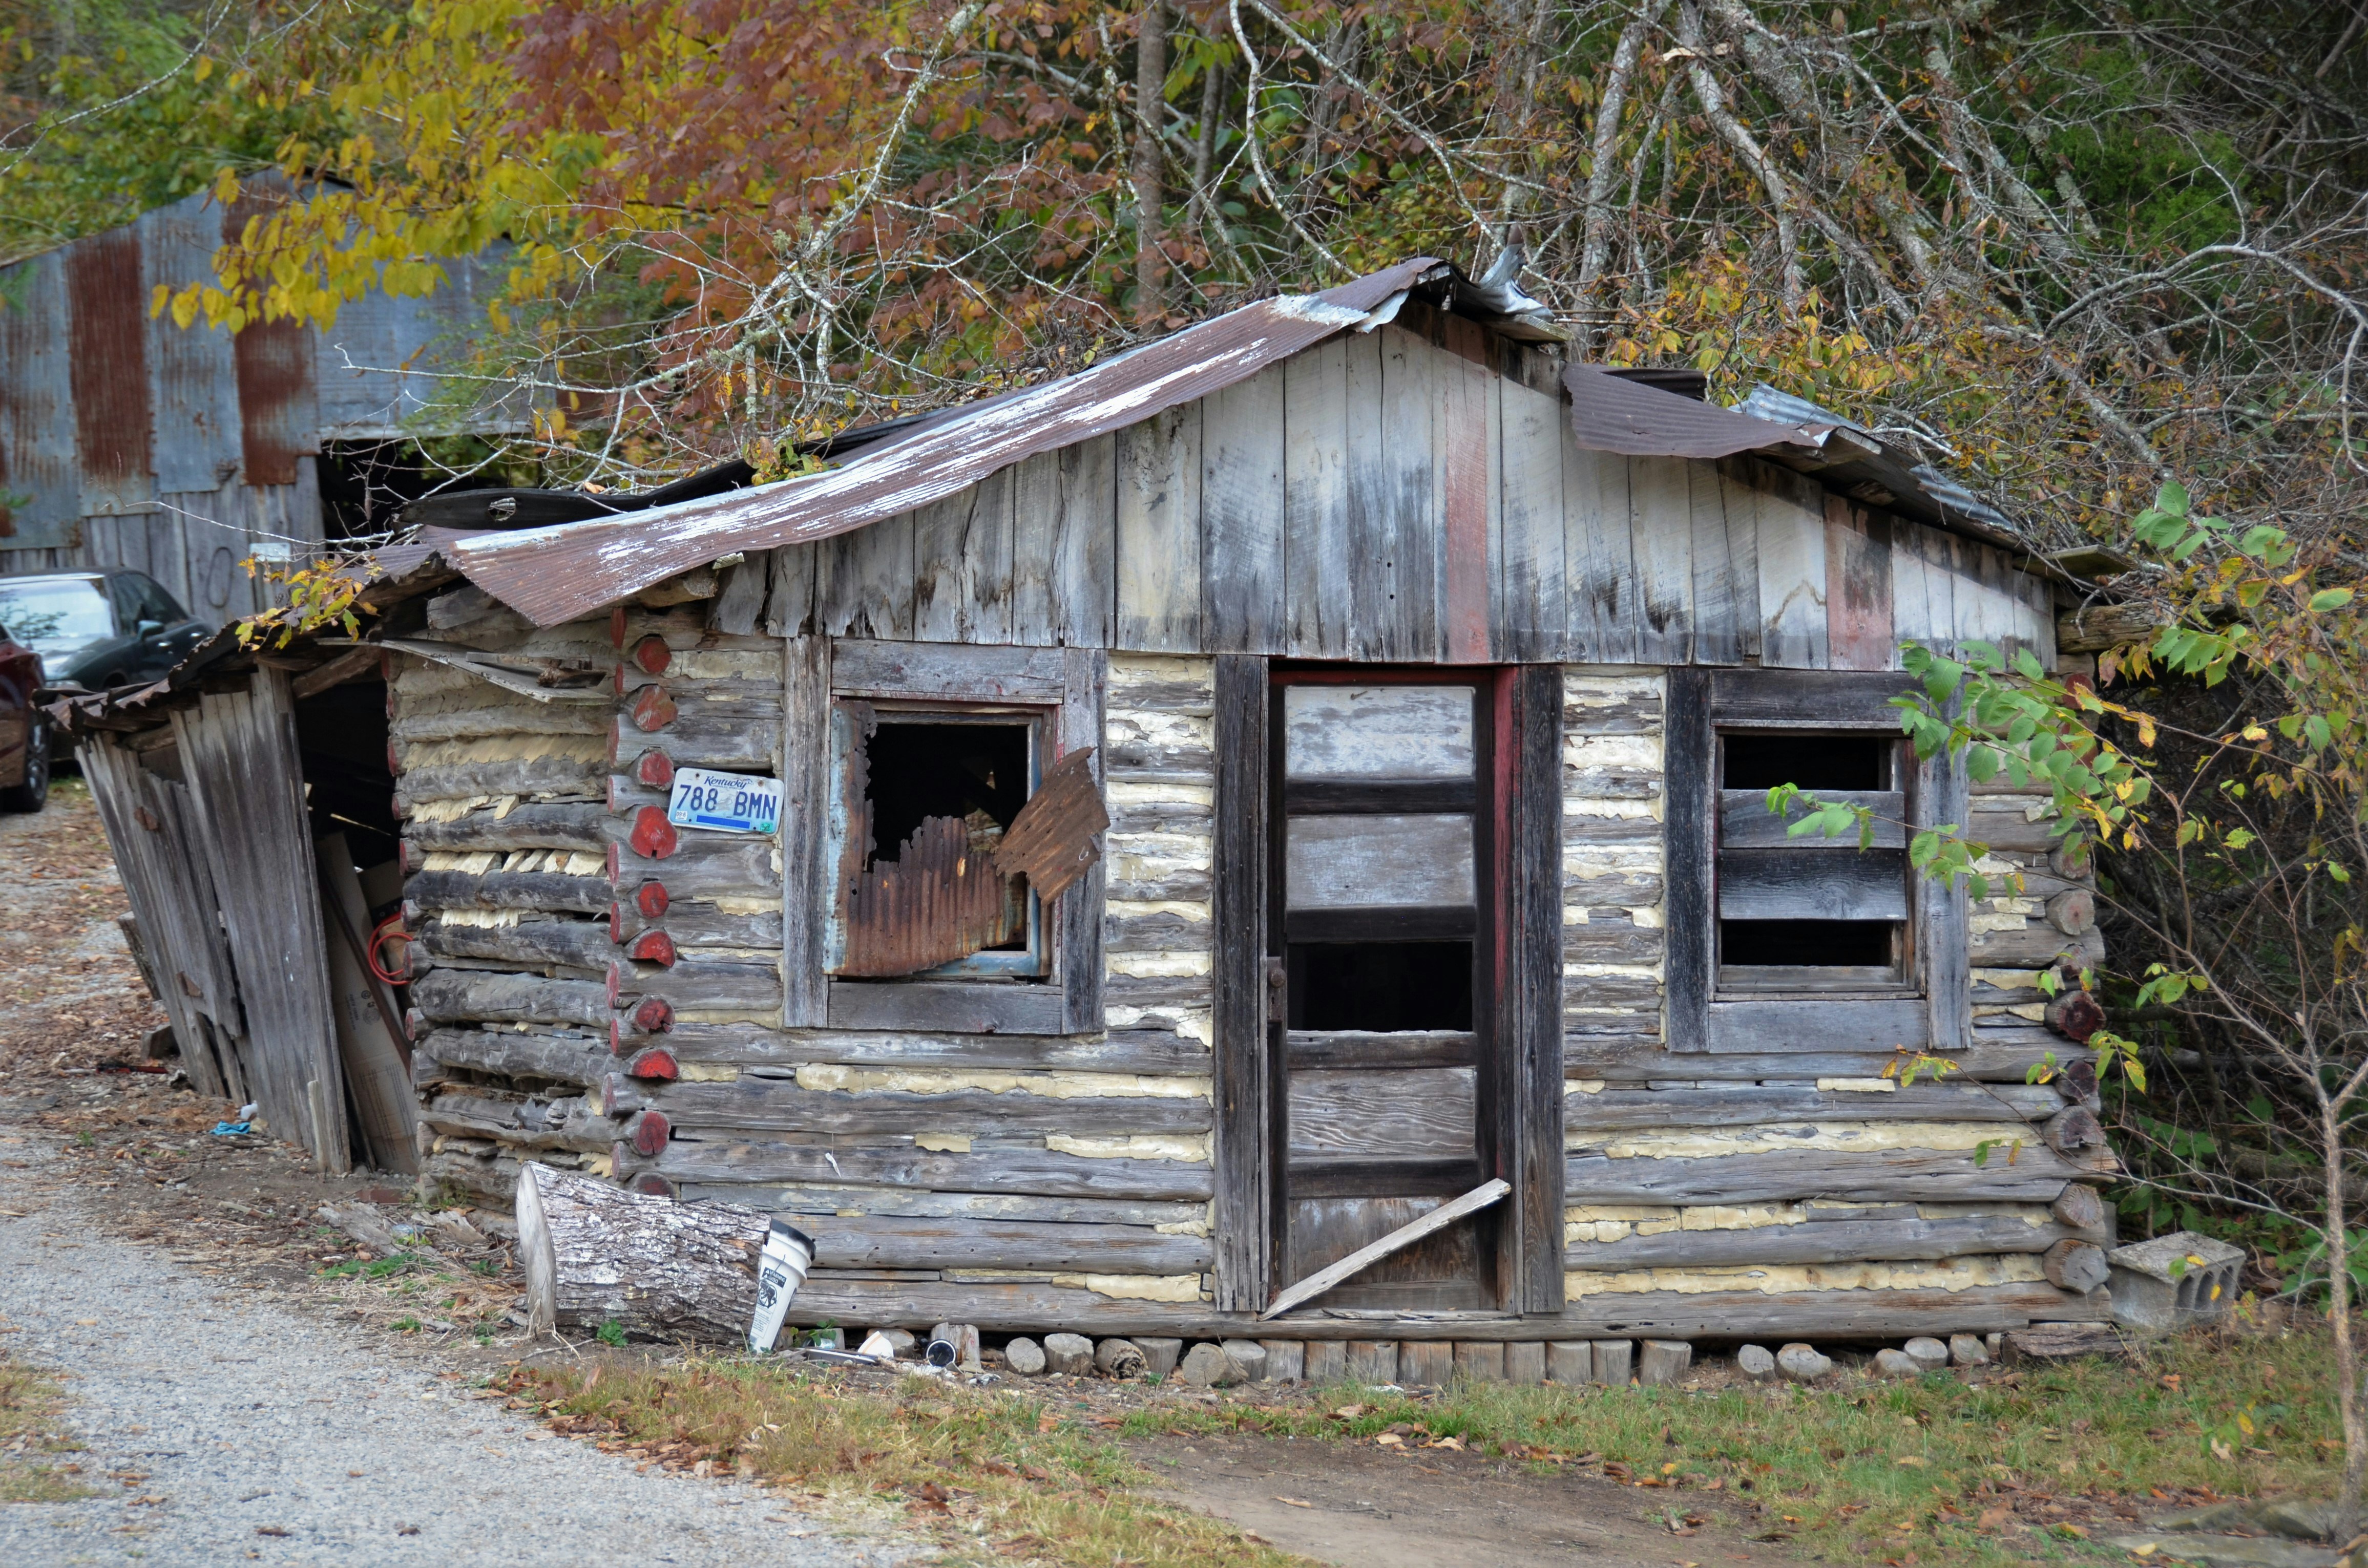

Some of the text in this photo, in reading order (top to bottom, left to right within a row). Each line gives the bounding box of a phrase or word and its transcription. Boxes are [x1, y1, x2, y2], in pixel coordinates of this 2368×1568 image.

[704, 776, 747, 790] Kentucky
[677, 785, 777, 820] 788 BMN
